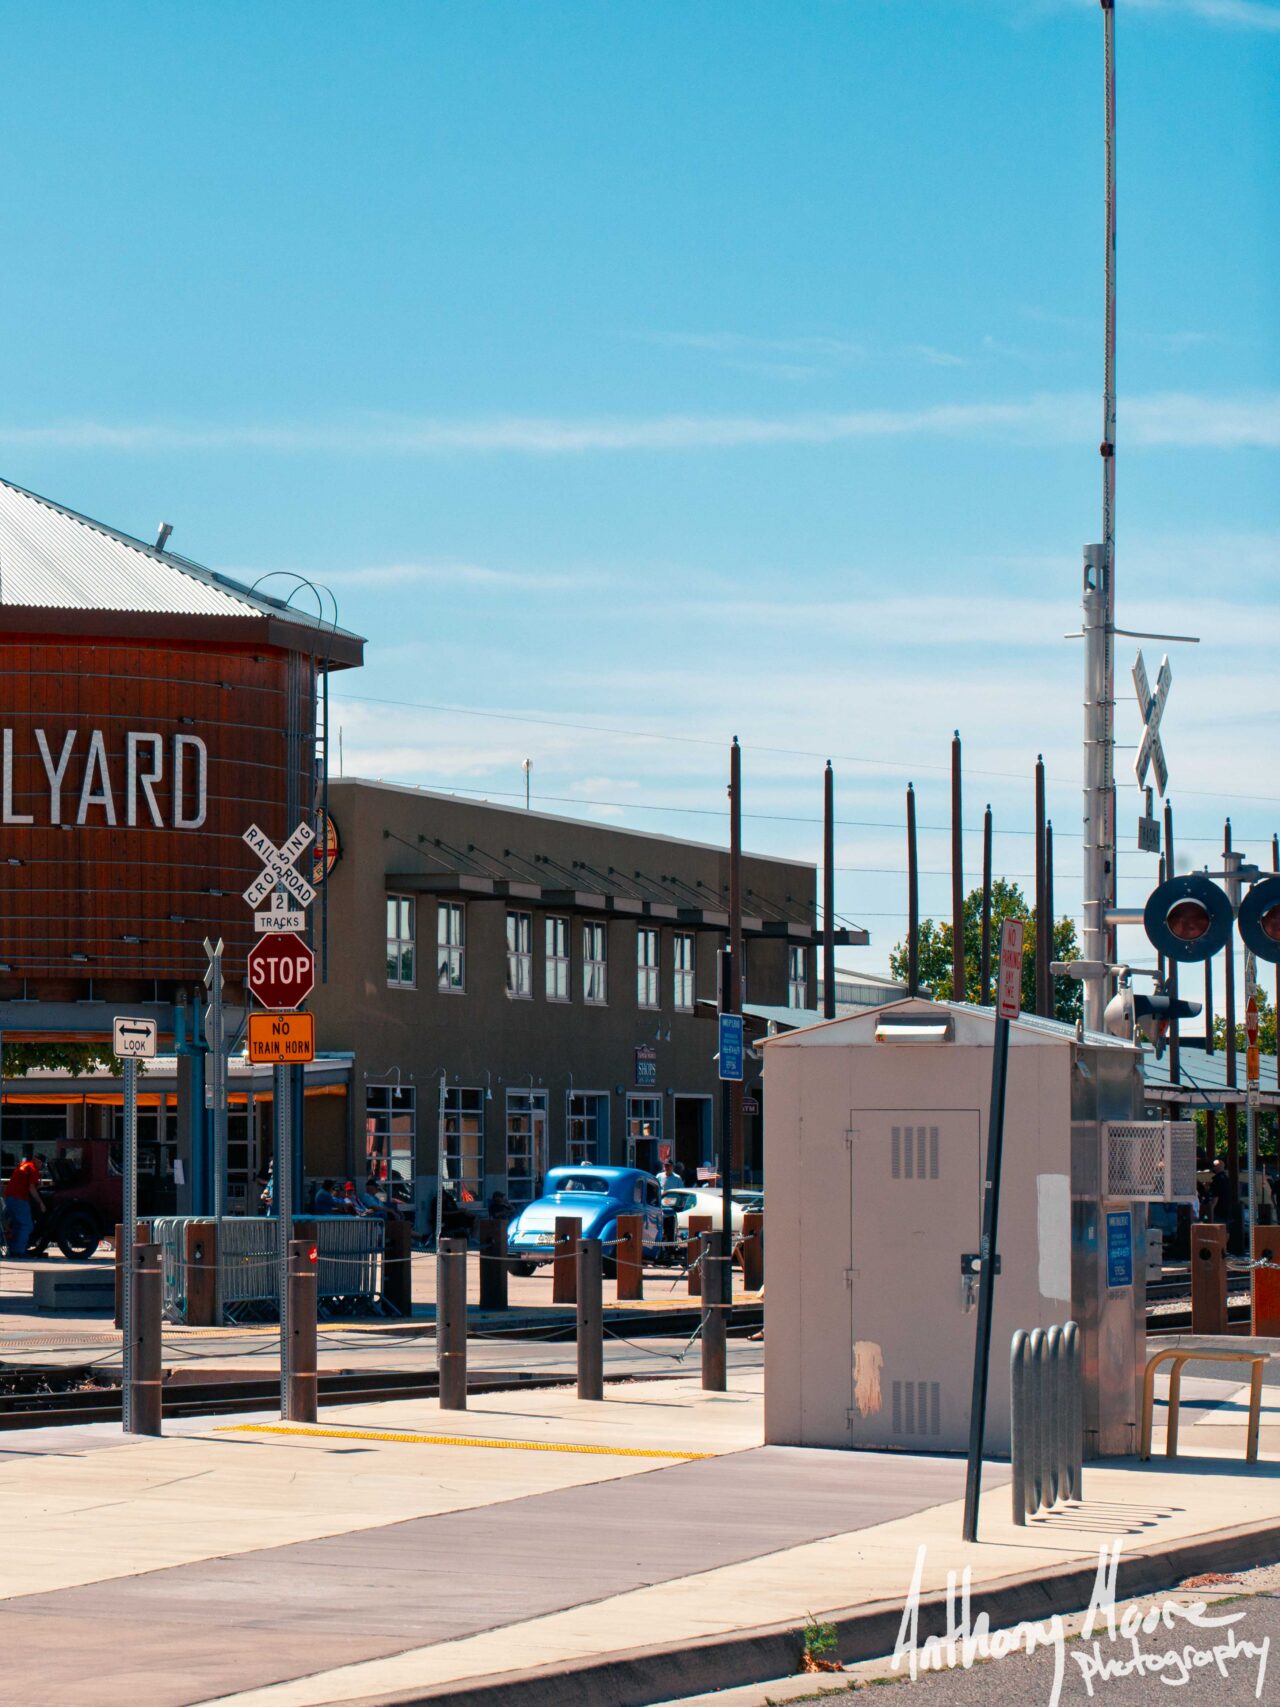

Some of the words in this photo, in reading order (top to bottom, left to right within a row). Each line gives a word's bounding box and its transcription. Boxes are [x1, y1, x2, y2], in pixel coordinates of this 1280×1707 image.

[247, 827, 311, 904] CROSSING
[276, 897, 284, 909] 2
[260, 917, 299, 927] TRACKS
[1008, 927, 1016, 947] NO
[1003, 949, 1021, 970] PARKING
[252, 957, 310, 985] STOP
[272, 1022, 290, 1035] NO
[124, 1040, 146, 1051] LOOK
[253, 1041, 280, 1054] TRAIN
[285, 1040, 310, 1054] HORN
